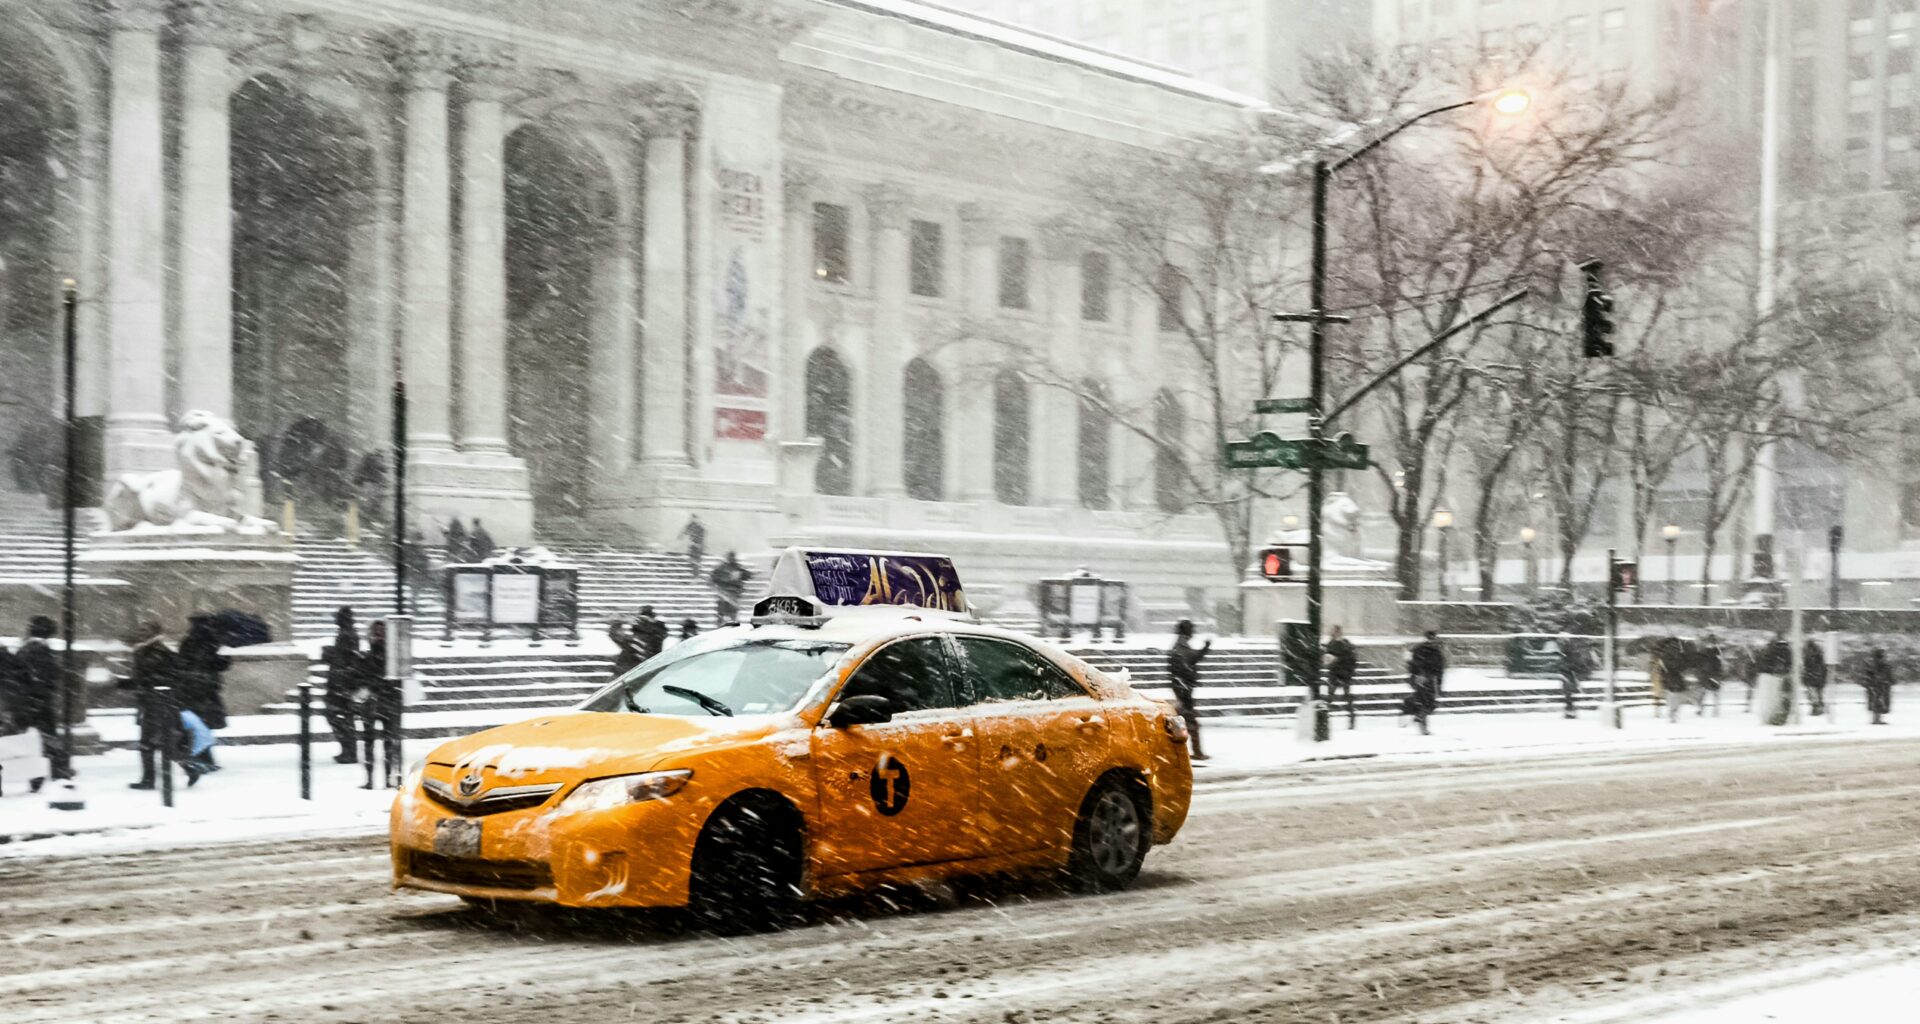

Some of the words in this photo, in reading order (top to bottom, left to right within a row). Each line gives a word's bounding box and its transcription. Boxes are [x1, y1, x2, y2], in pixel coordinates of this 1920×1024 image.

[813, 570, 849, 586] BIGGEST
[817, 585, 836, 601] NEW
[879, 768, 900, 808] T
